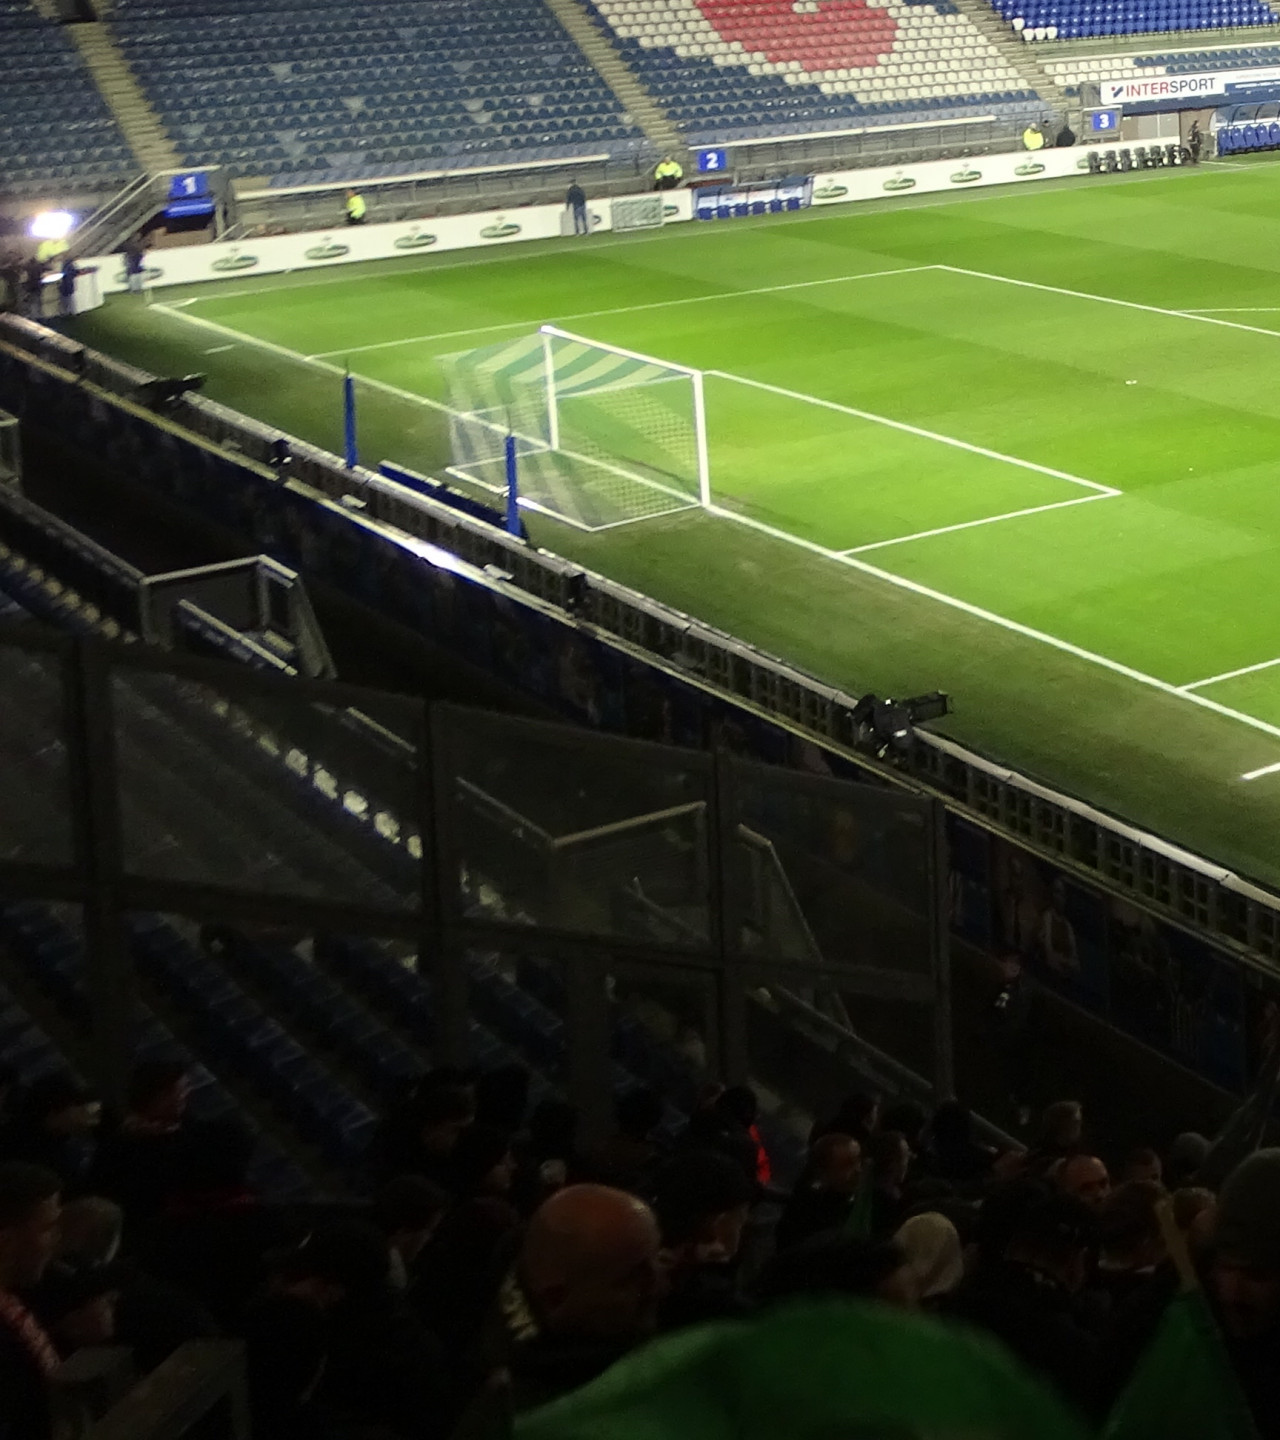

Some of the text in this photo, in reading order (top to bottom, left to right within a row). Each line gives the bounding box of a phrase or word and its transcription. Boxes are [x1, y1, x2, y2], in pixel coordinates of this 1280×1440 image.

[1126, 77, 1215, 98] INTERSPORT
[1099, 114, 1109, 128] 3
[705, 151, 718, 169] 2
[182, 176, 197, 194] 1
